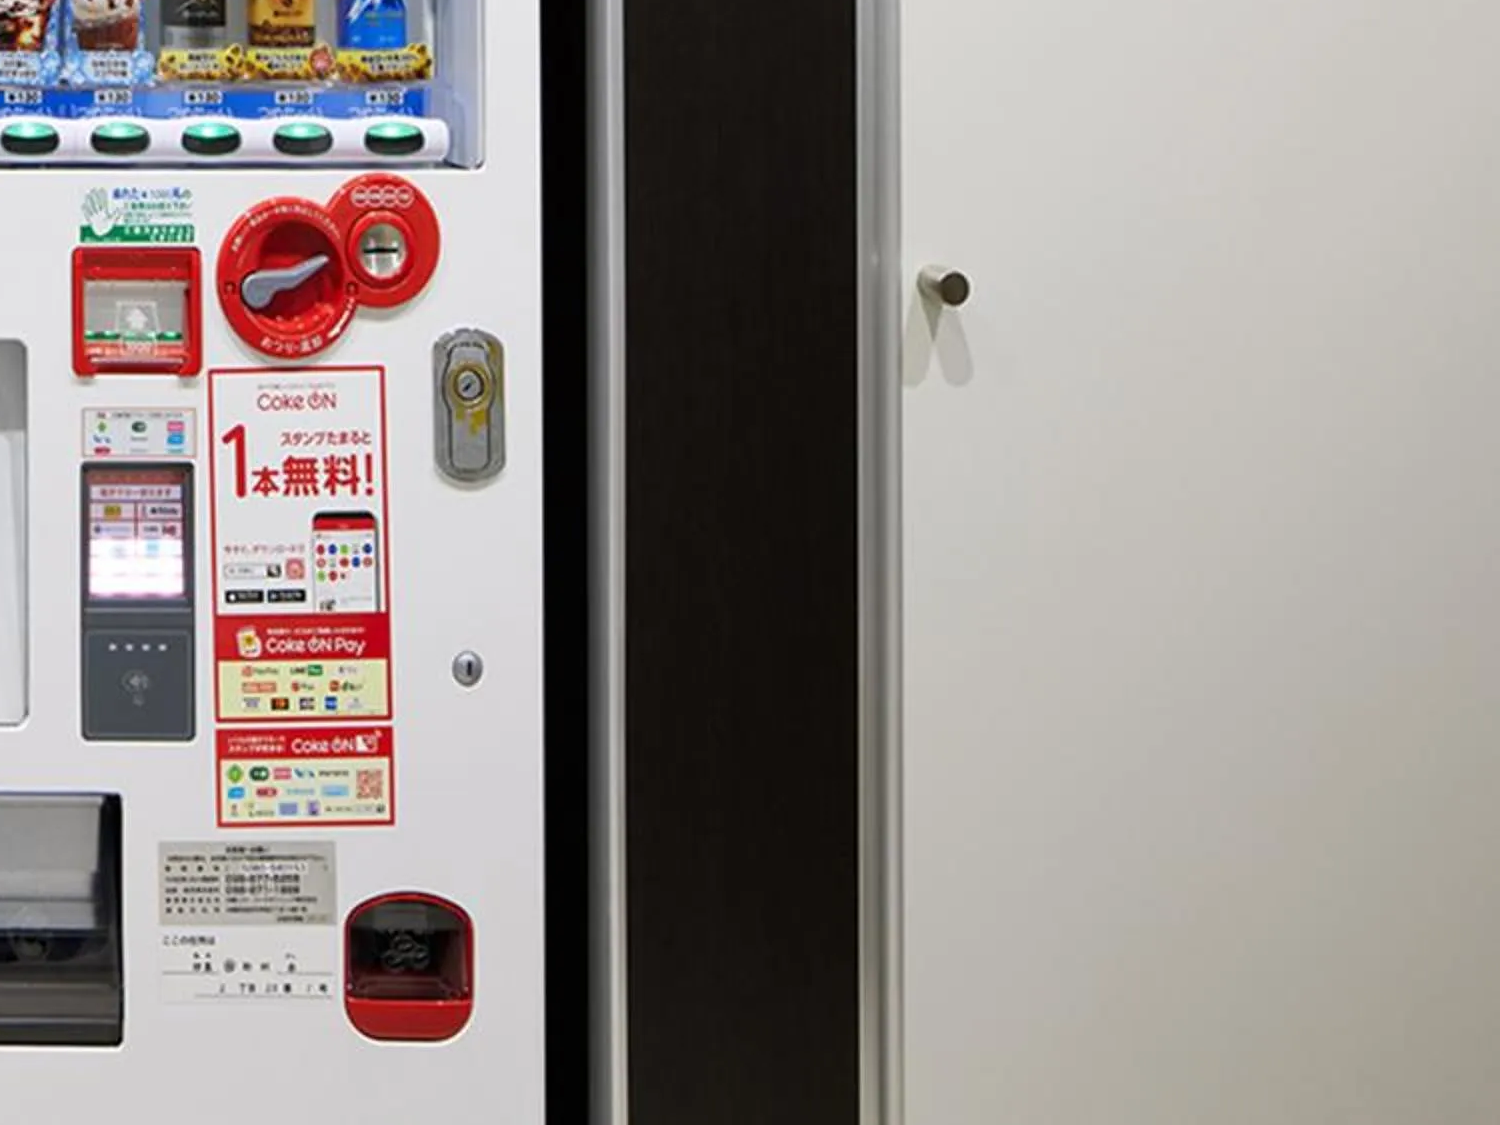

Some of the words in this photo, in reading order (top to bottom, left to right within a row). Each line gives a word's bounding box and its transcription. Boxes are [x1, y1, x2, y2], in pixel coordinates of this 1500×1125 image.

[257, 392, 305, 411] Coke
[280, 430, 372, 446] スタンプたまると
[265, 637, 305, 653] Coke
[334, 638, 367, 656] Pay
[291, 738, 330, 754] Coke
